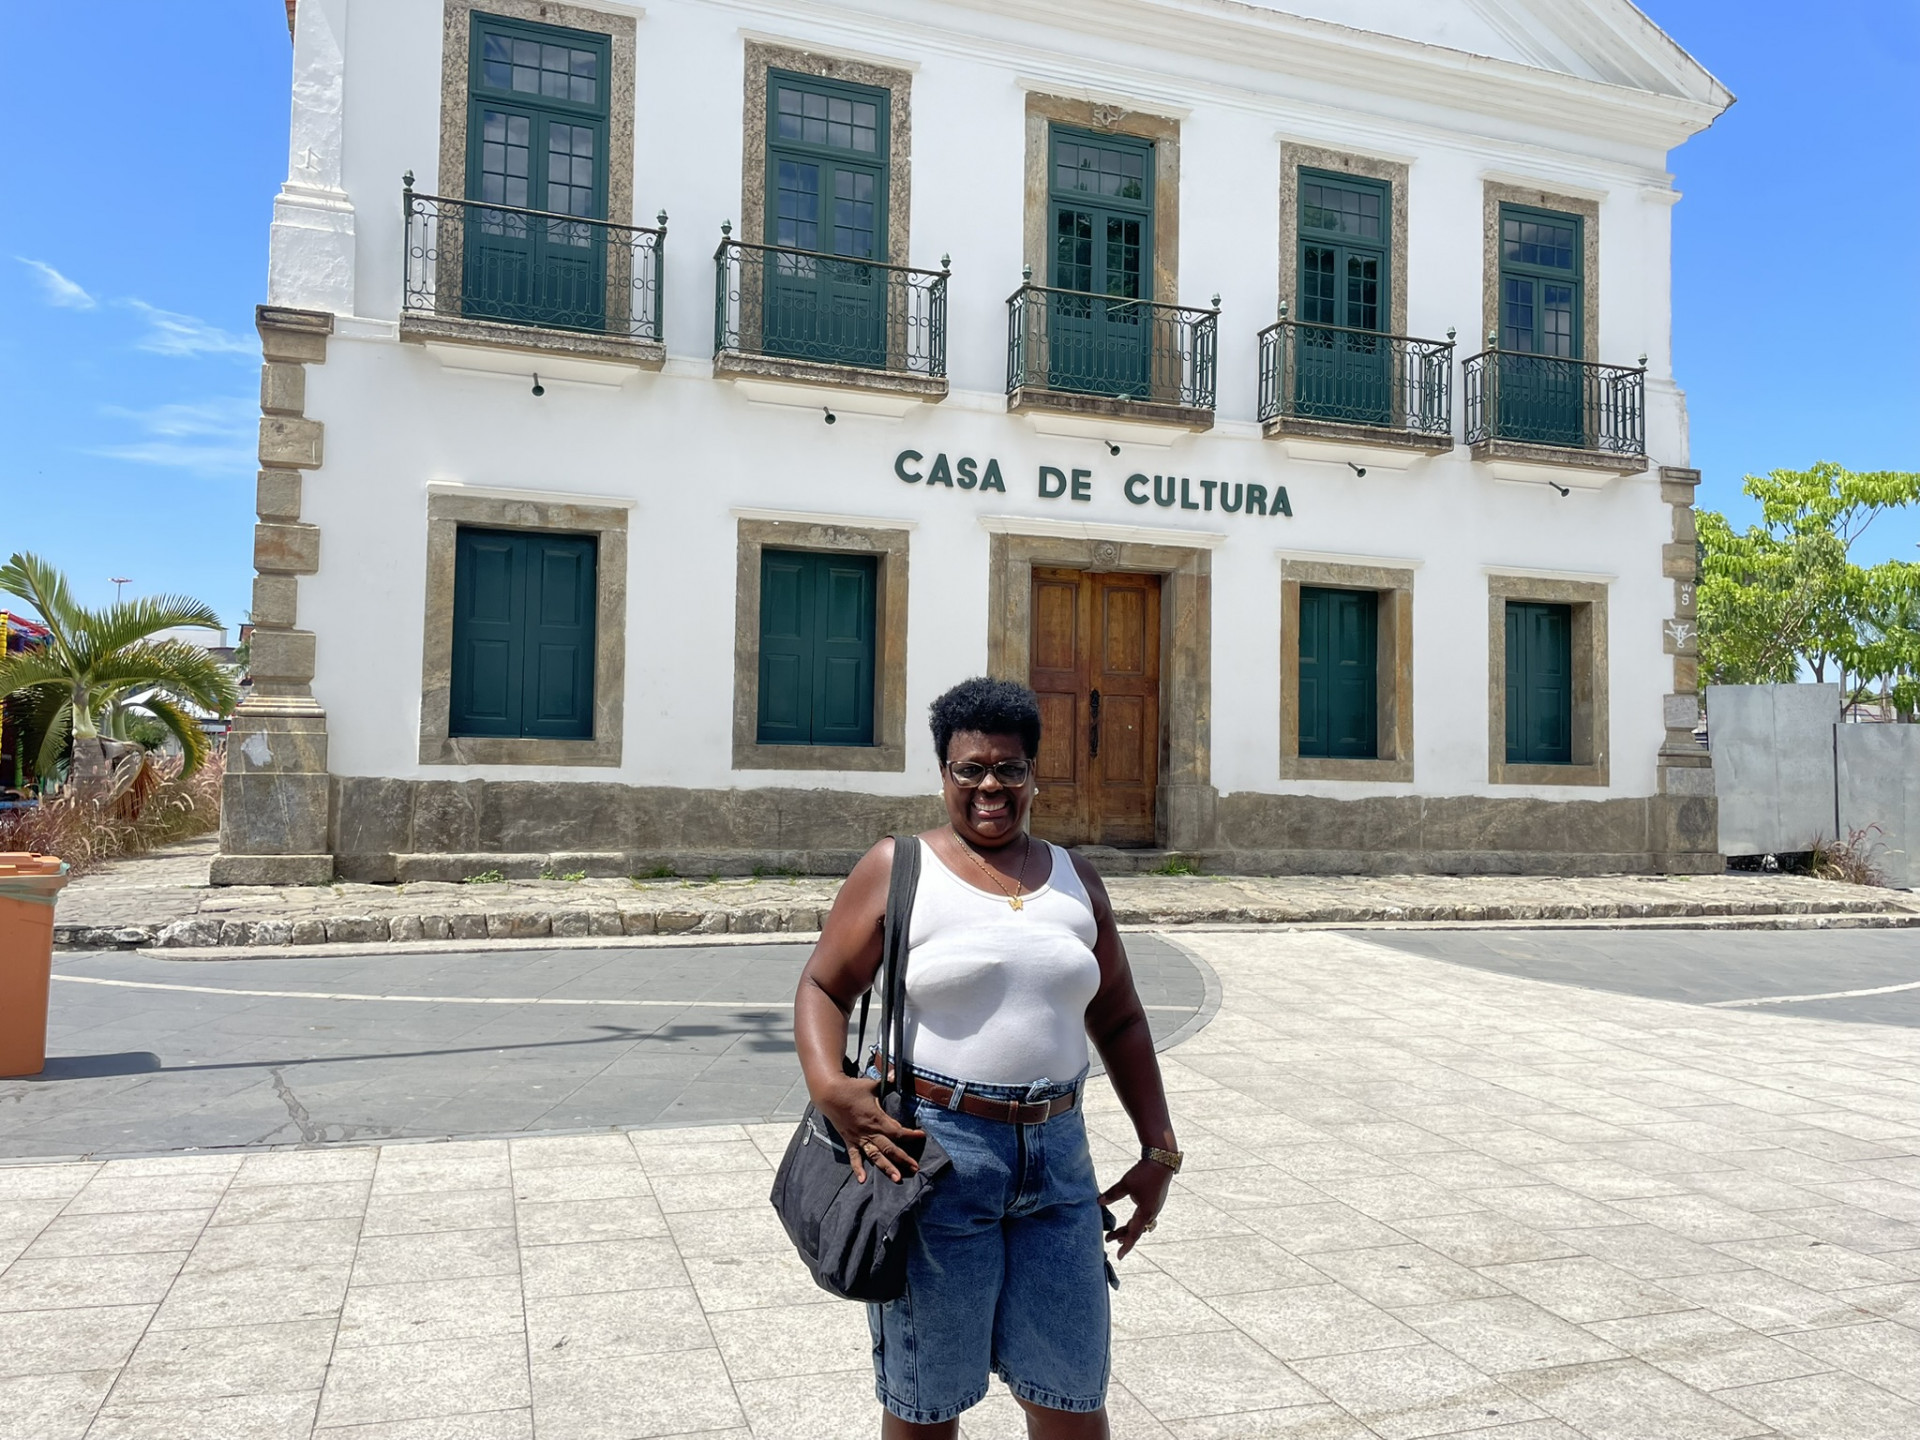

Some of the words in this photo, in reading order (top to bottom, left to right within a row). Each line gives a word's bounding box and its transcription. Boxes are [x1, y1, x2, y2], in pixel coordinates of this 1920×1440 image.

[895, 450, 1006, 493] CASA
[1038, 466, 1091, 501] DE
[1124, 474, 1293, 517] CULTURA
